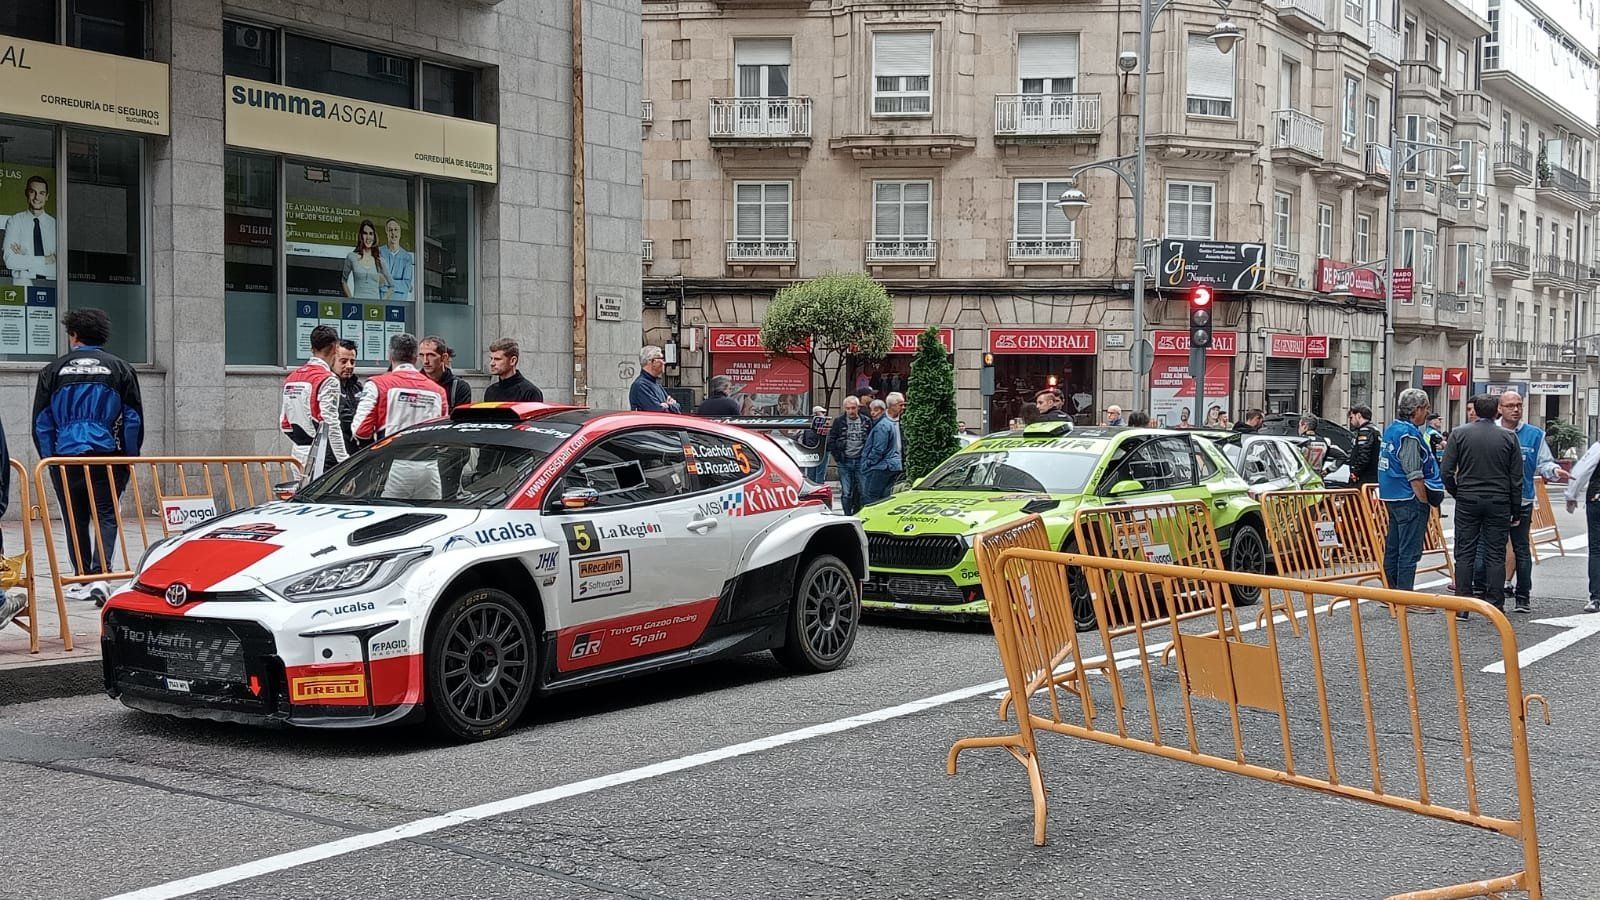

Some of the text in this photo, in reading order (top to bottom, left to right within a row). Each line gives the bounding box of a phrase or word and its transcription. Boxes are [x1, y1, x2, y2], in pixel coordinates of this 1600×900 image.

[41, 95, 159, 119] CORREDURÍA DE SEGUROS
[414, 153, 454, 165] CORREDURÍA
[465, 161, 493, 171] SEGUROS
[6, 169, 22, 180] LAS
[295, 204, 329, 214] AYUDAMOS
[336, 207, 360, 217] BUSCAR
[295, 212, 316, 221] MEJOR
[318, 214, 343, 223] SEGURO
[1323, 267, 1332, 284] DE
[1333, 268, 1355, 287] PDO
[1018, 335, 1089, 349] GENERALI
[1176, 337, 1233, 351] GERALI
[523, 434, 588, 499] www.msispain.com
[732, 443, 751, 475] 5
[475, 521, 537, 544] ucalsa
[573, 524, 591, 551] 5
[599, 520, 662, 540] La Región
[535, 551, 559, 570] JHK
[334, 601, 375, 615] ucalsa
[610, 625, 641, 636] TOYOTA
[673, 614, 698, 624] Racing
[380, 640, 407, 651] PAGID
[630, 631, 667, 646] Spain
[571, 640, 600, 658] GR
[297, 679, 360, 696] PIRELLI
